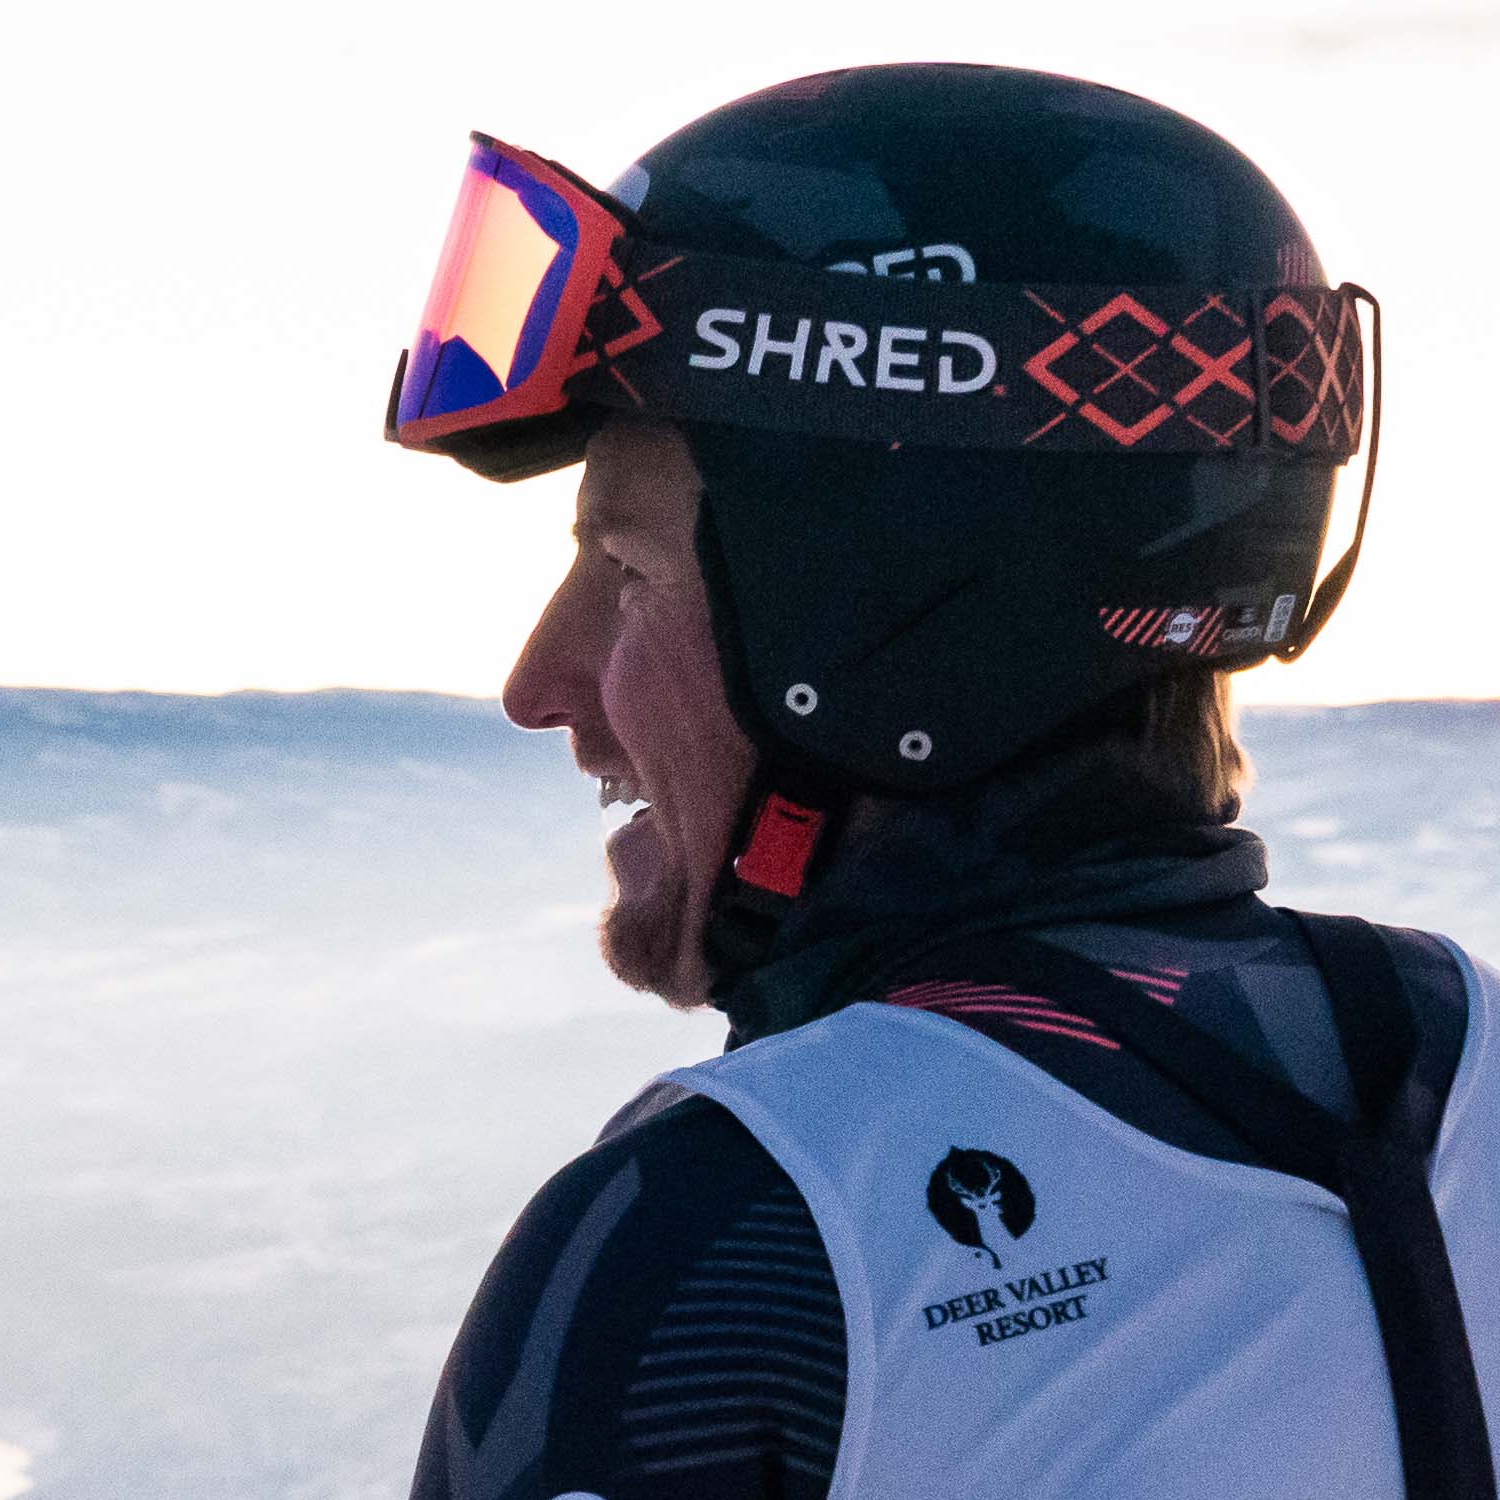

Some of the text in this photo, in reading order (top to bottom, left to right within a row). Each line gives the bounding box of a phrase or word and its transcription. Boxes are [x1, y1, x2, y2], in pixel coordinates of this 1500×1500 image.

[922, 1258, 1108, 1330] DEER VALLEY
[973, 1295, 1088, 1346] RESORT
